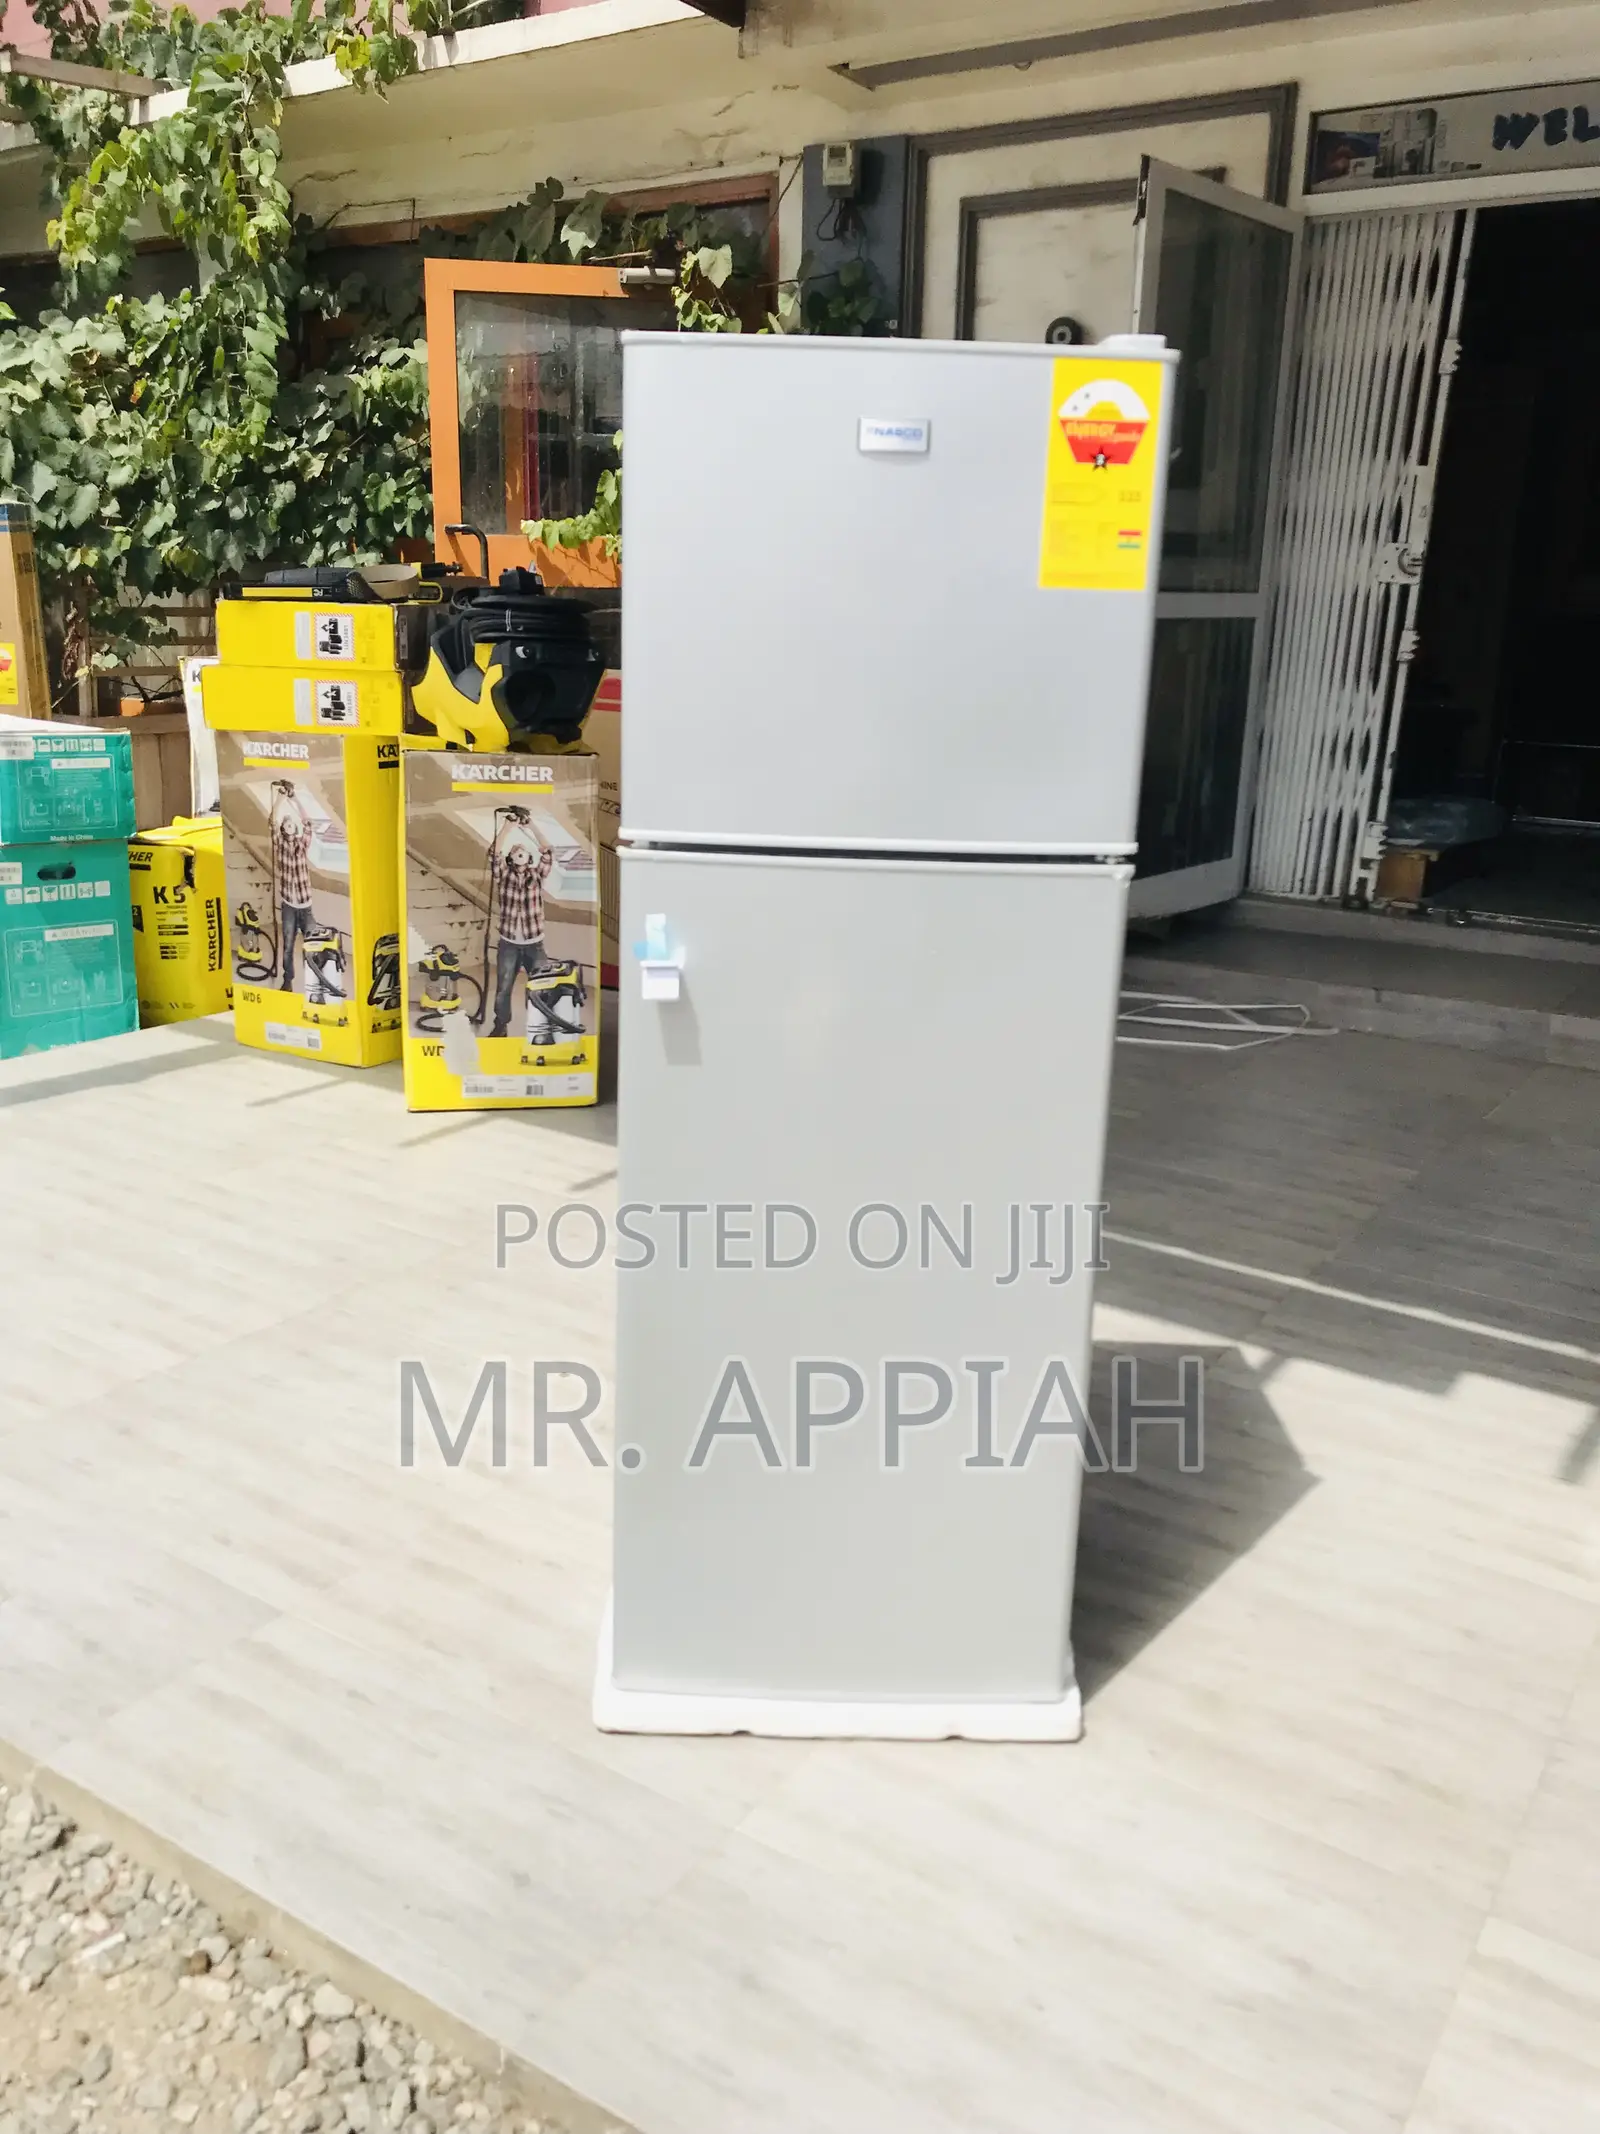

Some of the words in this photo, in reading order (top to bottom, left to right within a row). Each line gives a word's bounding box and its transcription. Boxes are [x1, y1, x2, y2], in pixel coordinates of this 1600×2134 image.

[243, 741, 309, 759] KÄRCHER
[377, 744, 399, 758] KÄ
[452, 764, 554, 781] KÄRCHER
[129, 852, 153, 862] HER
[206, 898, 216, 972] KÄRCHER
[242, 990, 256, 1002] WD
[256, 995, 262, 1003] 6
